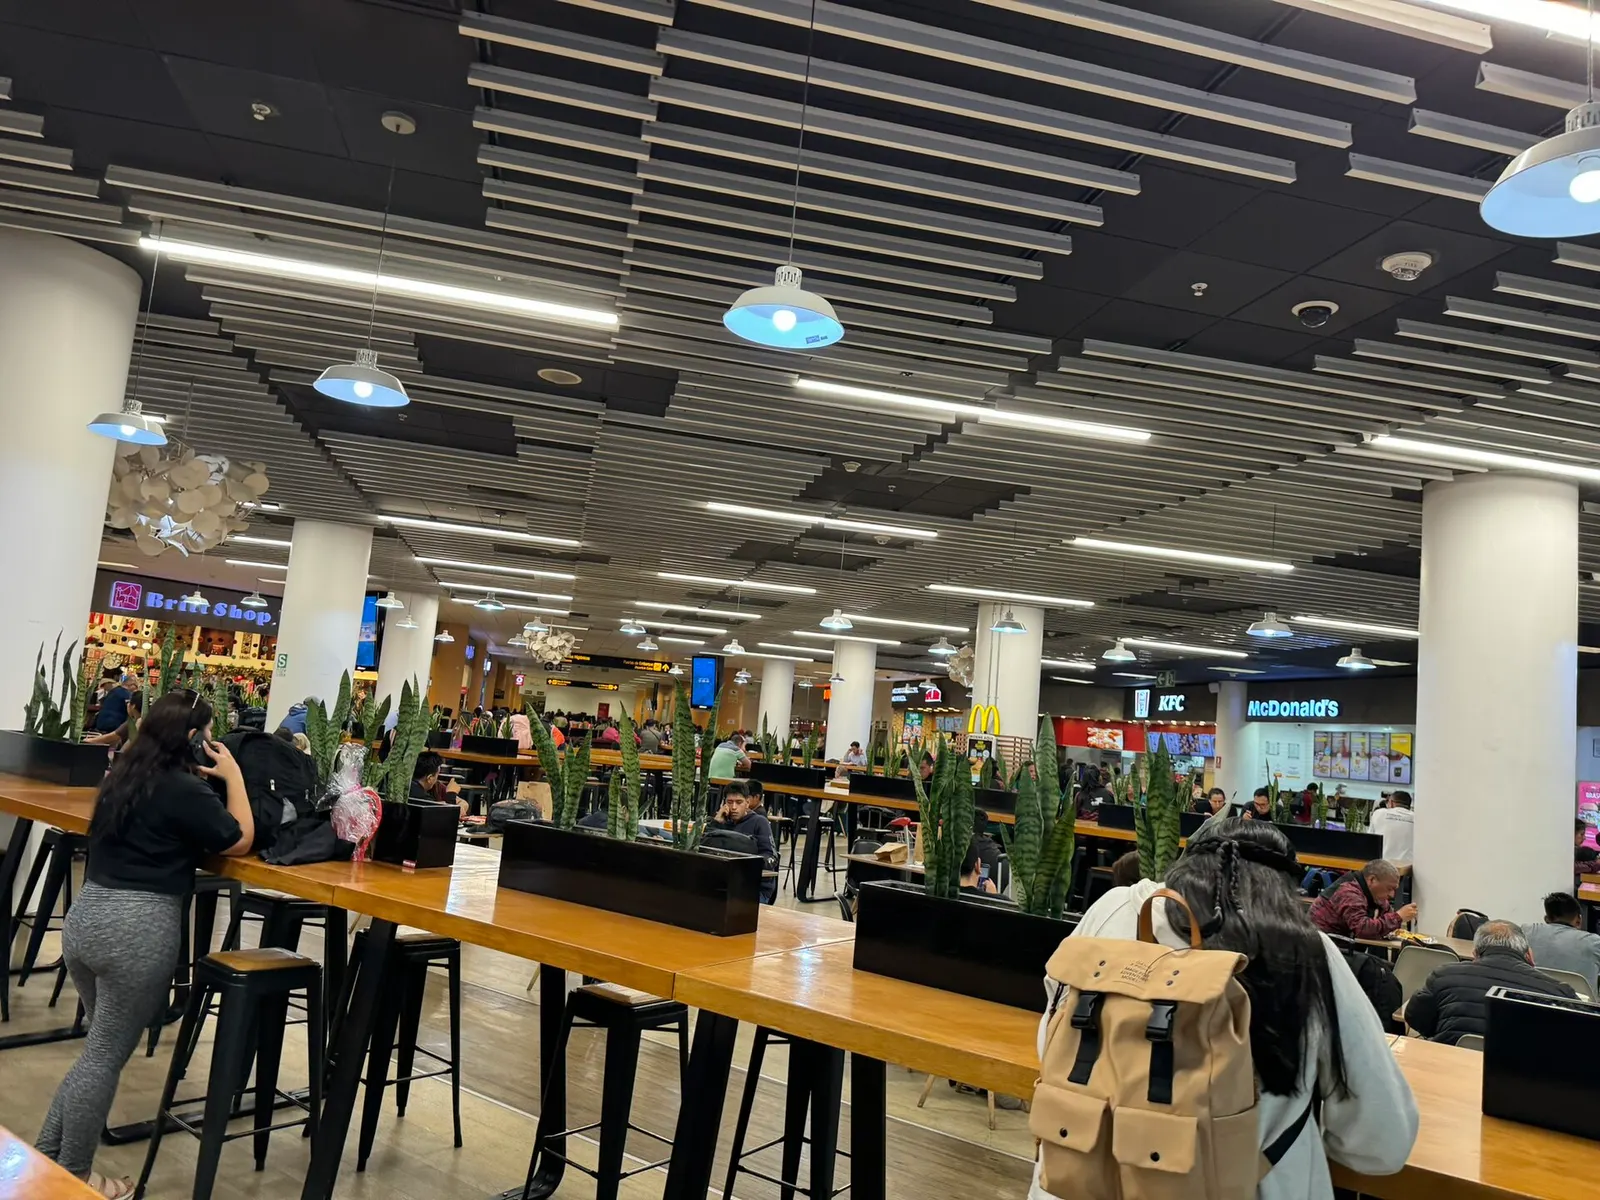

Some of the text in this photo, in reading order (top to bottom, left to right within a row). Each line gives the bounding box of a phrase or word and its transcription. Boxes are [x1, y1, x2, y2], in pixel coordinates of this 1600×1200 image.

[213, 602, 272, 626] Shop
[278, 655, 286, 667] S
[1158, 694, 1185, 711] KFC
[1247, 699, 1339, 717] McDonald's
